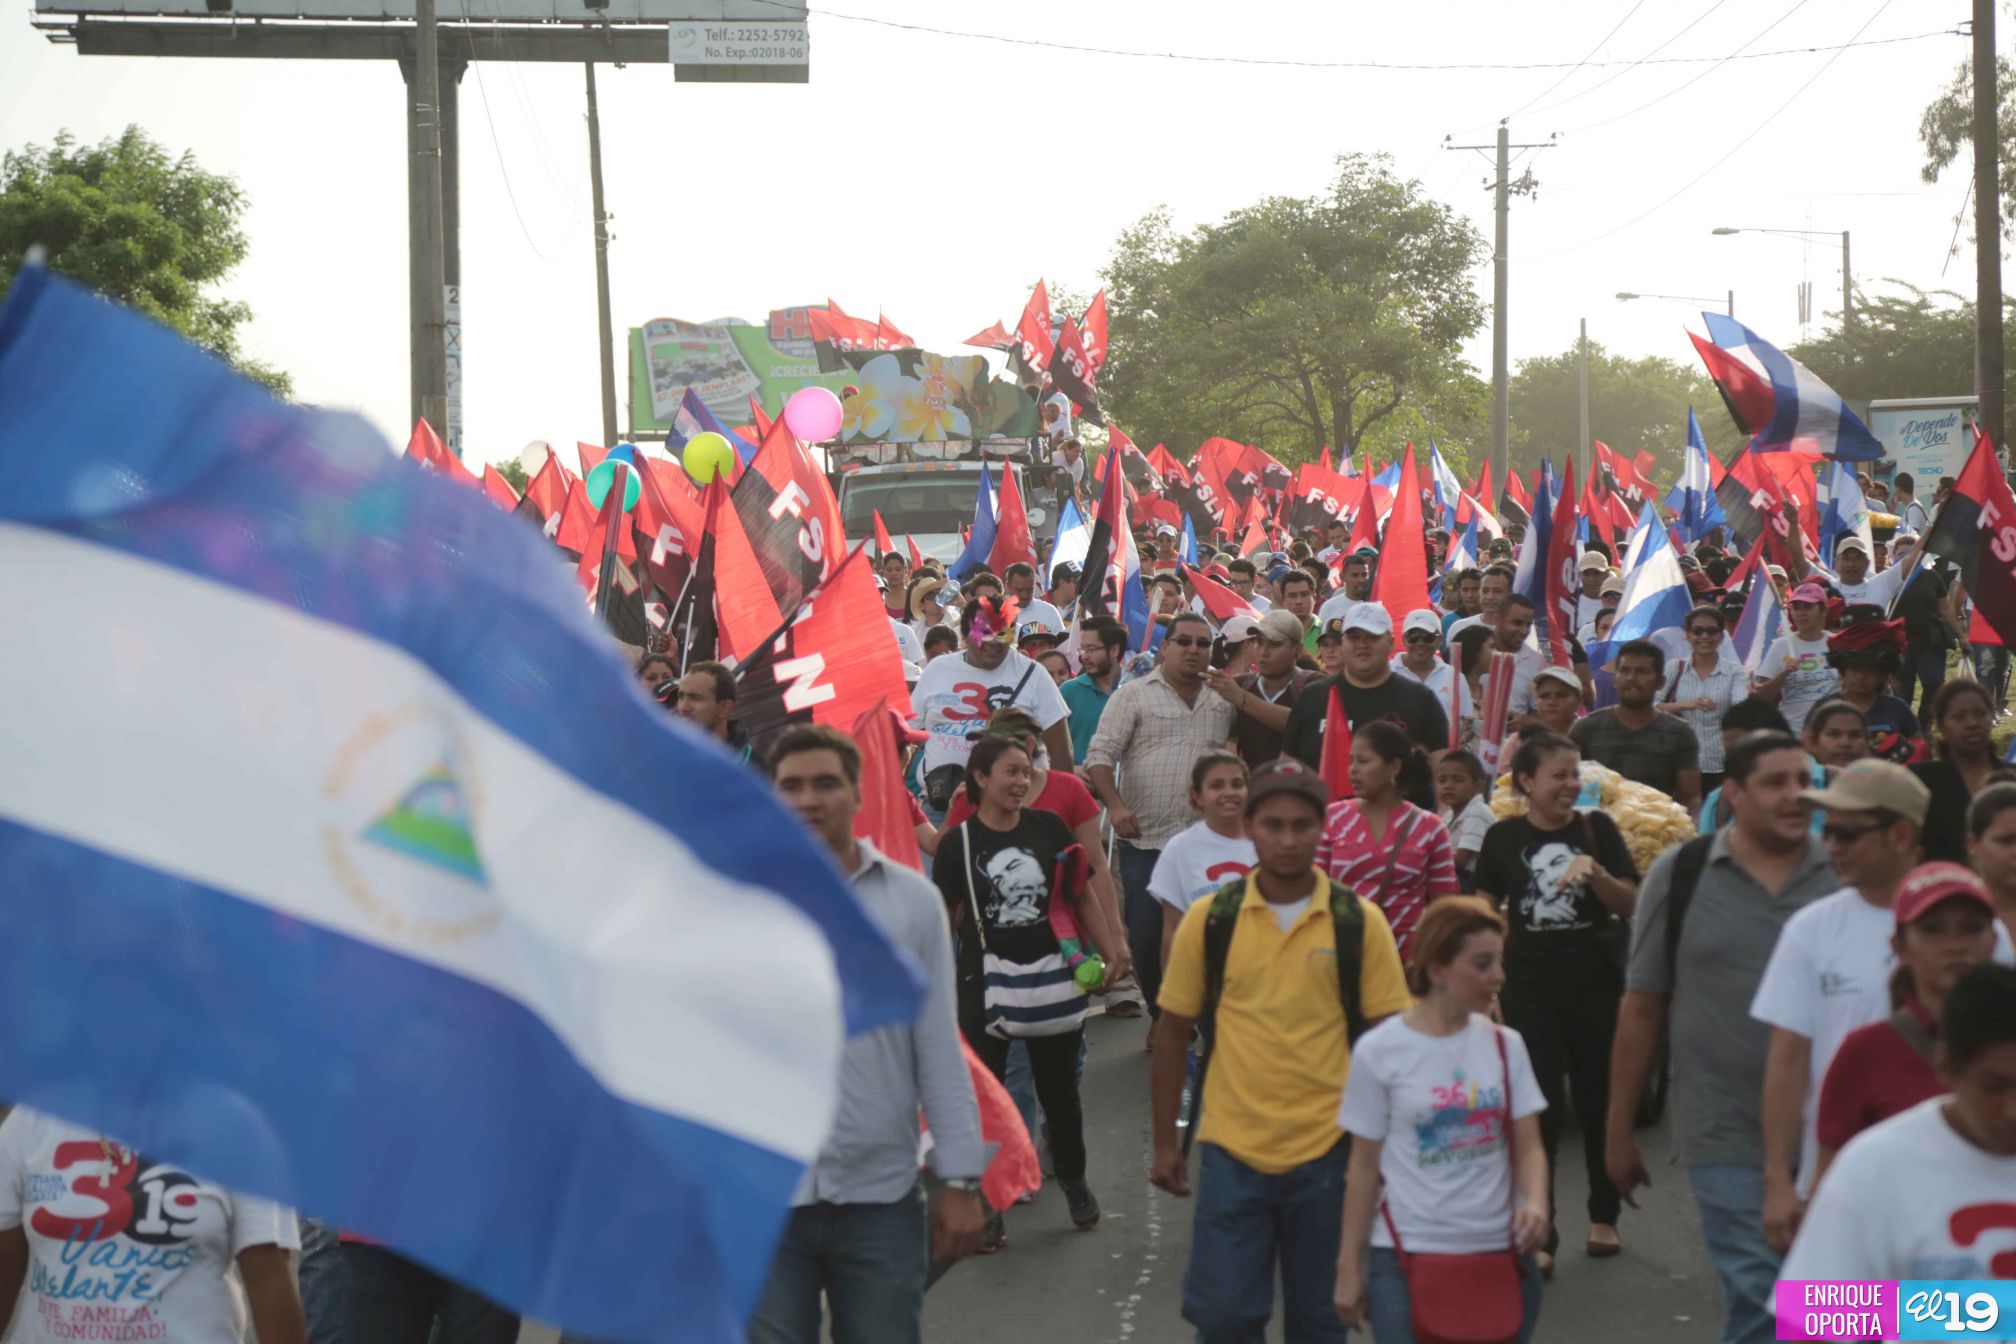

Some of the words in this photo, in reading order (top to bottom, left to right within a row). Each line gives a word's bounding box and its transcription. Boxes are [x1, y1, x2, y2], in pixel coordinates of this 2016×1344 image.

[704, 28, 735, 41] Telf.:
[737, 29, 804, 41] 2252-5792
[704, 48, 723, 58] No.
